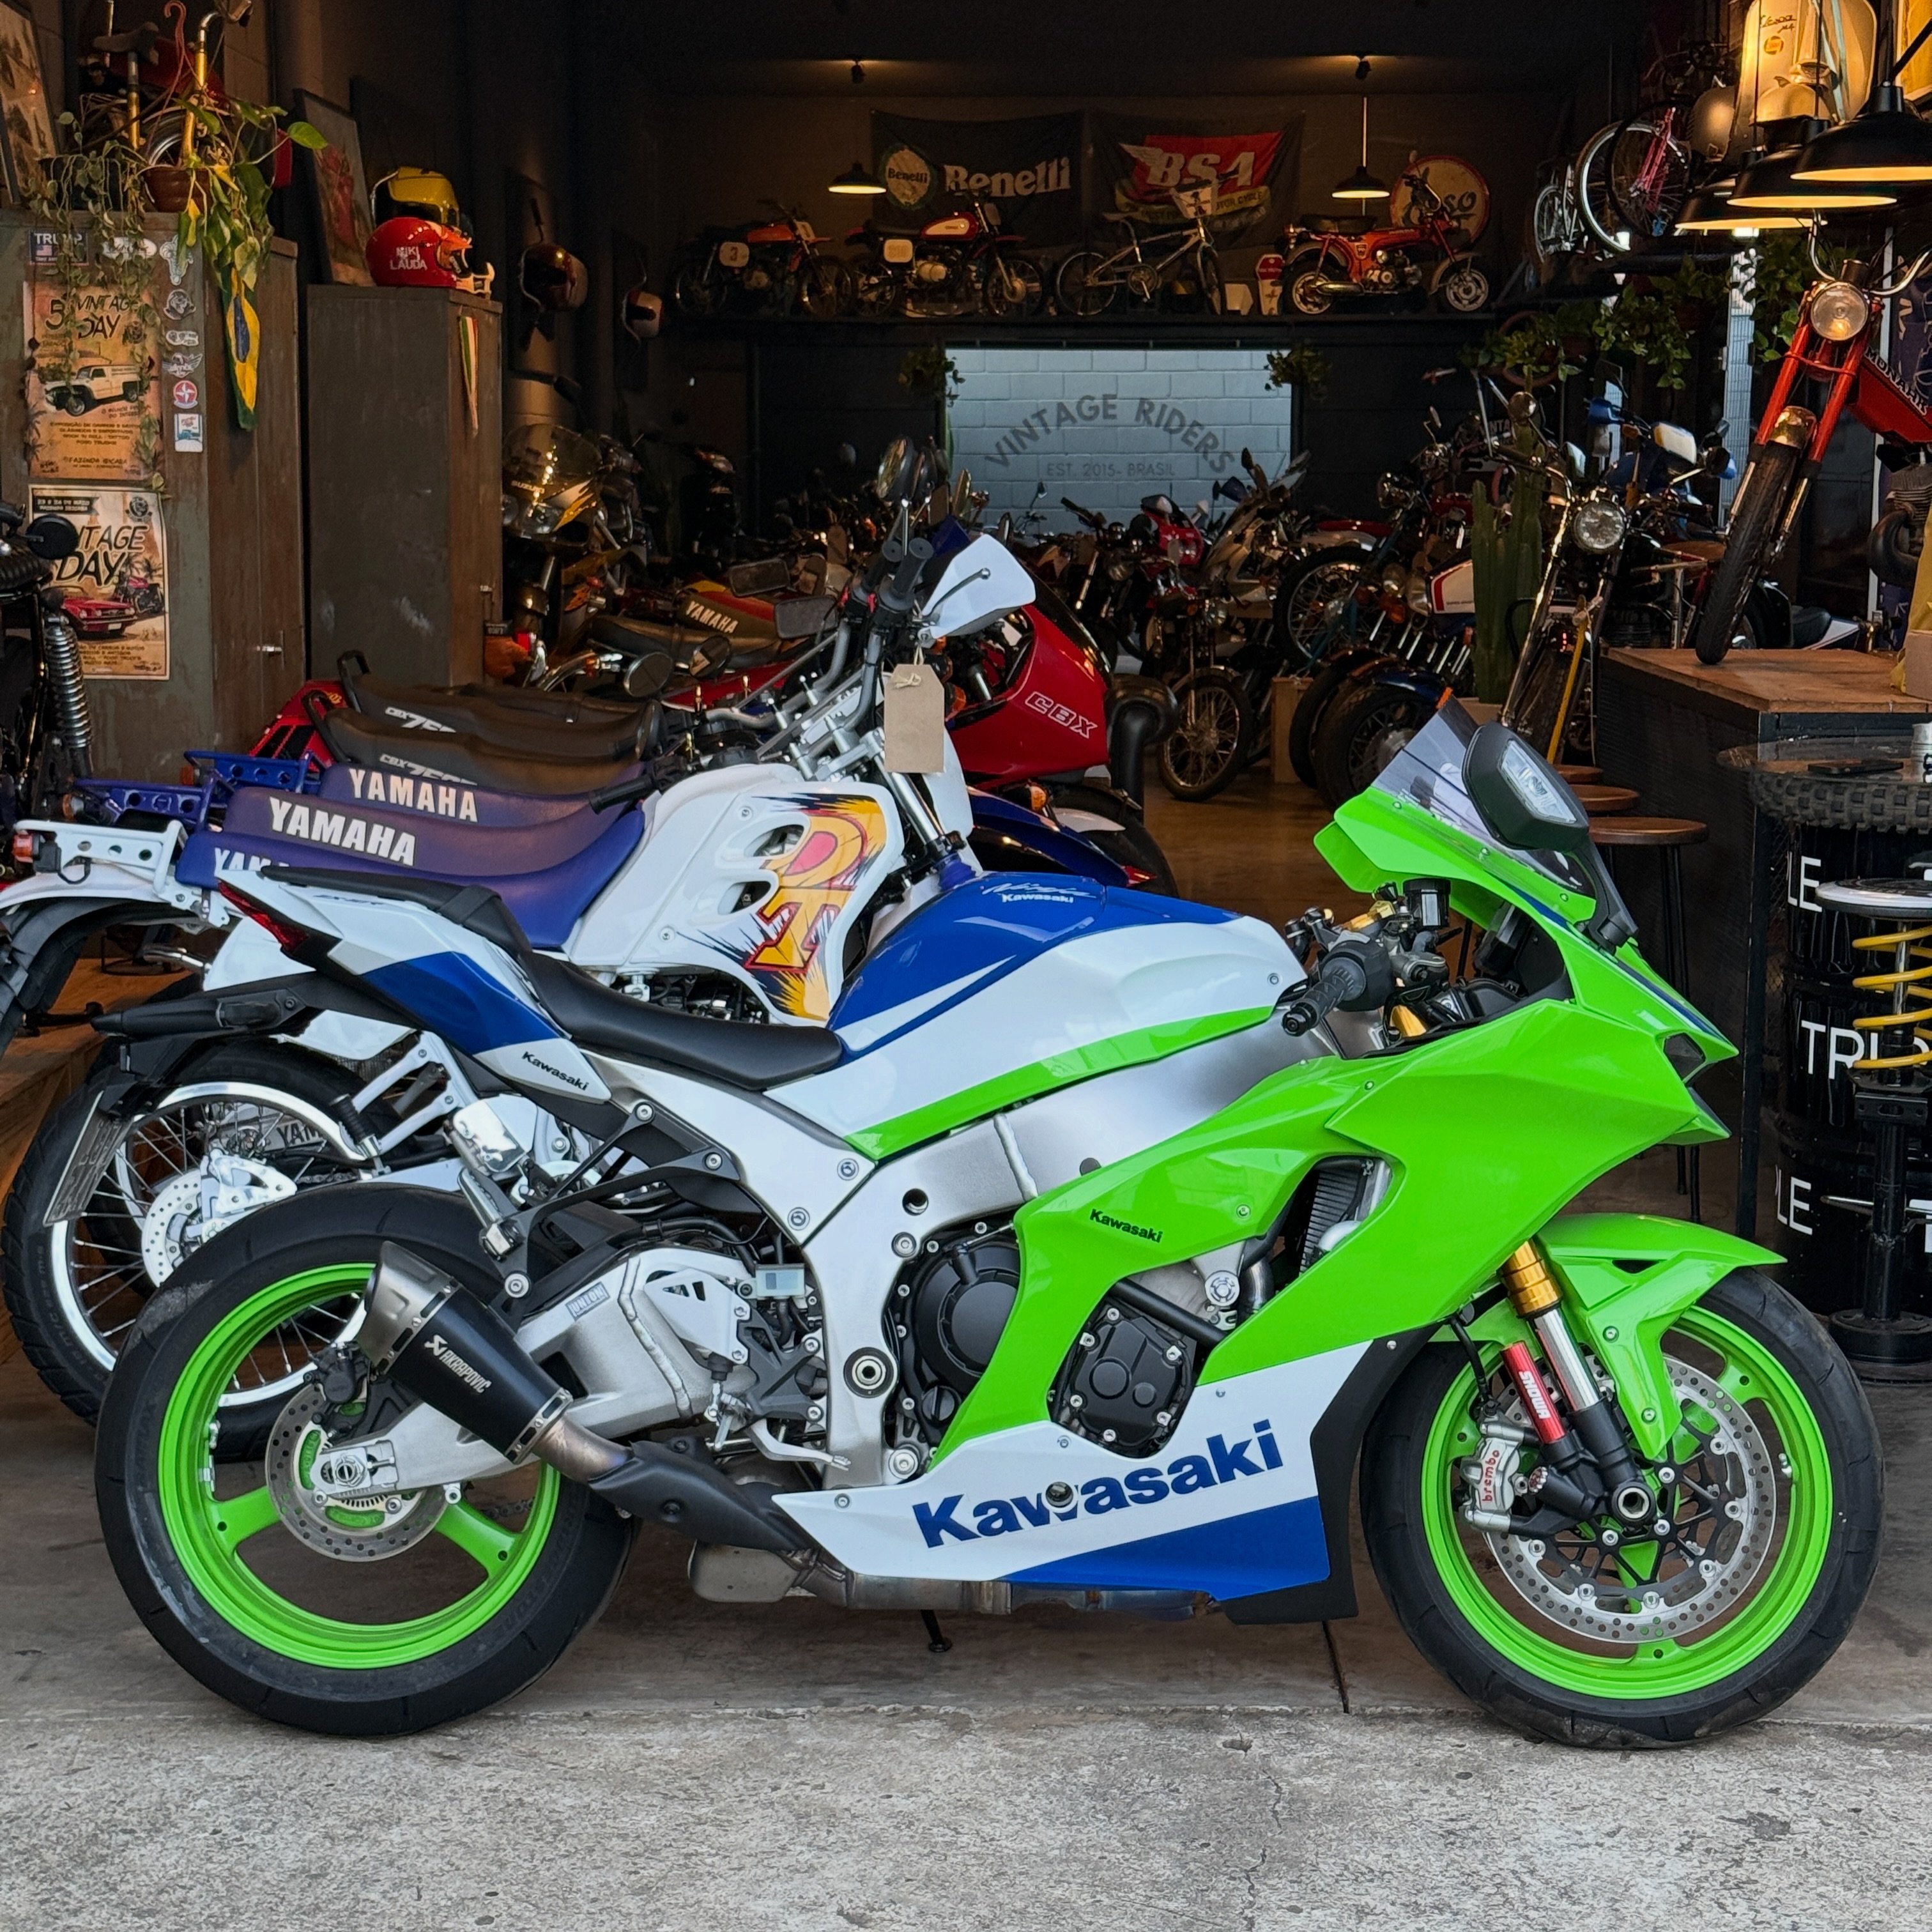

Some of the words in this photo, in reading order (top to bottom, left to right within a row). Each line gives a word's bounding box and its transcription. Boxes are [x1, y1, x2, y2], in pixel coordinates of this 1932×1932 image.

[888, 167, 927, 184] Benelli
[943, 157, 1071, 197] Benelli
[390, 259, 427, 270] LAUDA
[985, 394, 1117, 468] VINTAGE
[1135, 397, 1235, 473] RIDERS
[1046, 463, 1077, 477] EST.
[1128, 463, 1175, 477] BRASIL
[55, 550, 127, 586] DAY
[685, 601, 739, 634] YAMAHA
[1025, 691, 1098, 739] CBX
[349, 769, 479, 824] YAMAHA
[269, 796, 417, 866] YAMAHA
[1001, 893, 1074, 903] Kawasaki
[521, 1051, 590, 1091] Kawasaki
[1089, 1208, 1163, 1243] Kawasaki
[1518, 1370, 1551, 1419] SHOWA
[912, 1418, 1284, 1549] Kawasaki
[1482, 1450, 1500, 1503] brembo
